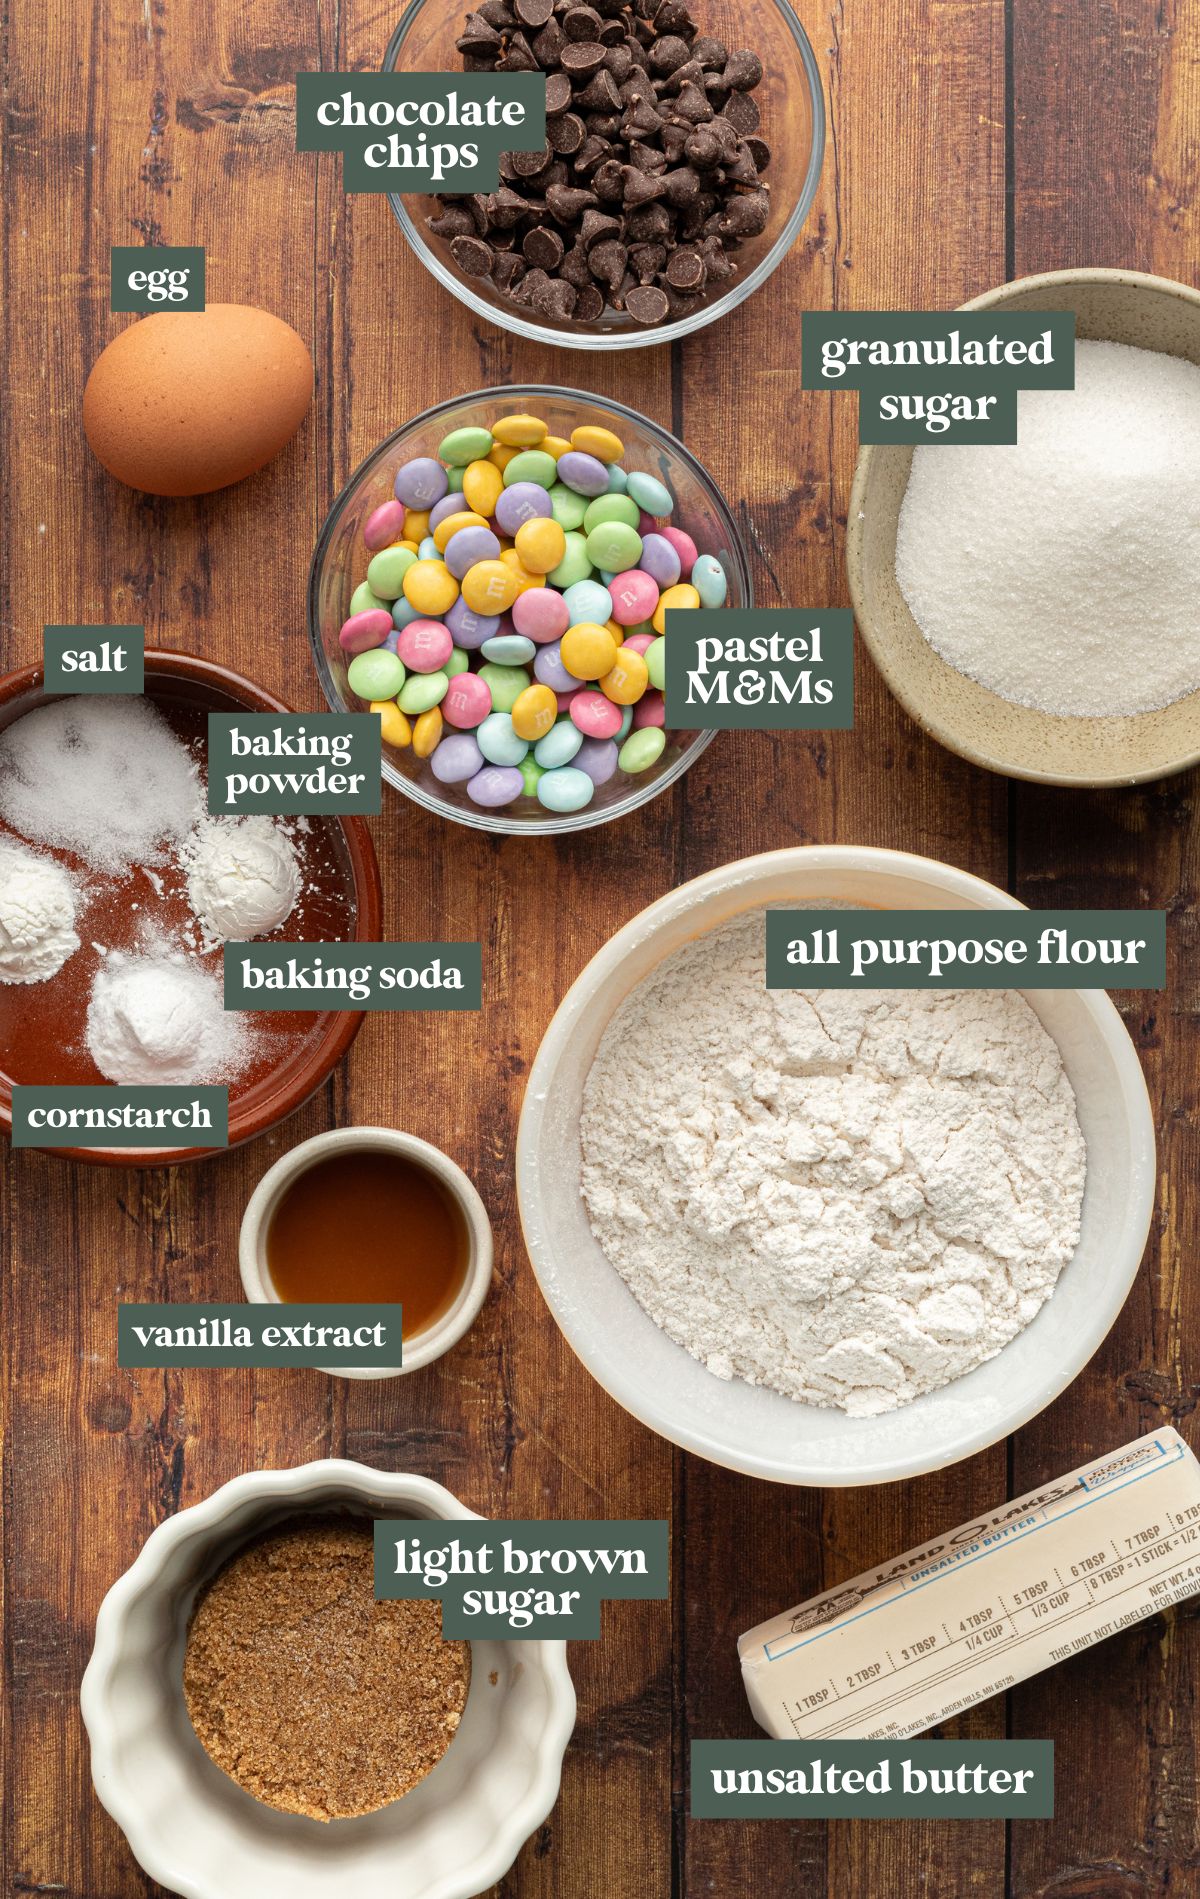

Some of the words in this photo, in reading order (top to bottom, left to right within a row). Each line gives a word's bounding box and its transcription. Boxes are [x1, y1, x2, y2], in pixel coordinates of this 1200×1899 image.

[1175, 1513, 1185, 1525] 8
[876, 1545, 944, 1584] LAND
[949, 1524, 988, 1545] O
[992, 1488, 1064, 1525] LAKES
[1125, 1538, 1132, 1549] 7
[1133, 1526, 1160, 1544] TBSP
[911, 1544, 979, 1581] UNSALTED
[983, 1517, 1035, 1546] BUTTER
[1090, 1578, 1098, 1589] 8
[1098, 1565, 1124, 1584] TBSP
[1134, 1557, 1141, 1567] 1
[1142, 1541, 1173, 1563] STICK
[1180, 1529, 1197, 1543] 1/2
[1071, 1566, 1079, 1576] 6
[1079, 1552, 1105, 1572] TBSP
[1013, 1594, 1022, 1605] 5
[1022, 1581, 1048, 1600] TBSP
[1149, 1580, 1168, 1597] NET
[1168, 1572, 1187, 1586] WT.
[1188, 1568, 1194, 1577] 4
[1032, 1603, 1048, 1617] 1/3
[1049, 1592, 1069, 1608] CUP
[960, 1622, 966, 1631] 4
[966, 1608, 992, 1628] TBSP
[1049, 1645, 1071, 1660] THIS
[1071, 1633, 1093, 1650] UNIT
[1094, 1623, 1112, 1639] NOT
[1114, 1604, 1153, 1629] LABELED
[1154, 1594, 1174, 1609] FOR
[902, 1650, 910, 1660] 3
[910, 1636, 936, 1655] TBSP
[965, 1635, 982, 1650] 1/4
[983, 1625, 1003, 1641] CUP
[847, 1677, 855, 1687] 2
[854, 1663, 880, 1682] TBSP
[796, 1702, 802, 1712] 1
[802, 1689, 828, 1708] TBSP
[942, 1700, 963, 1716] ARDEN
